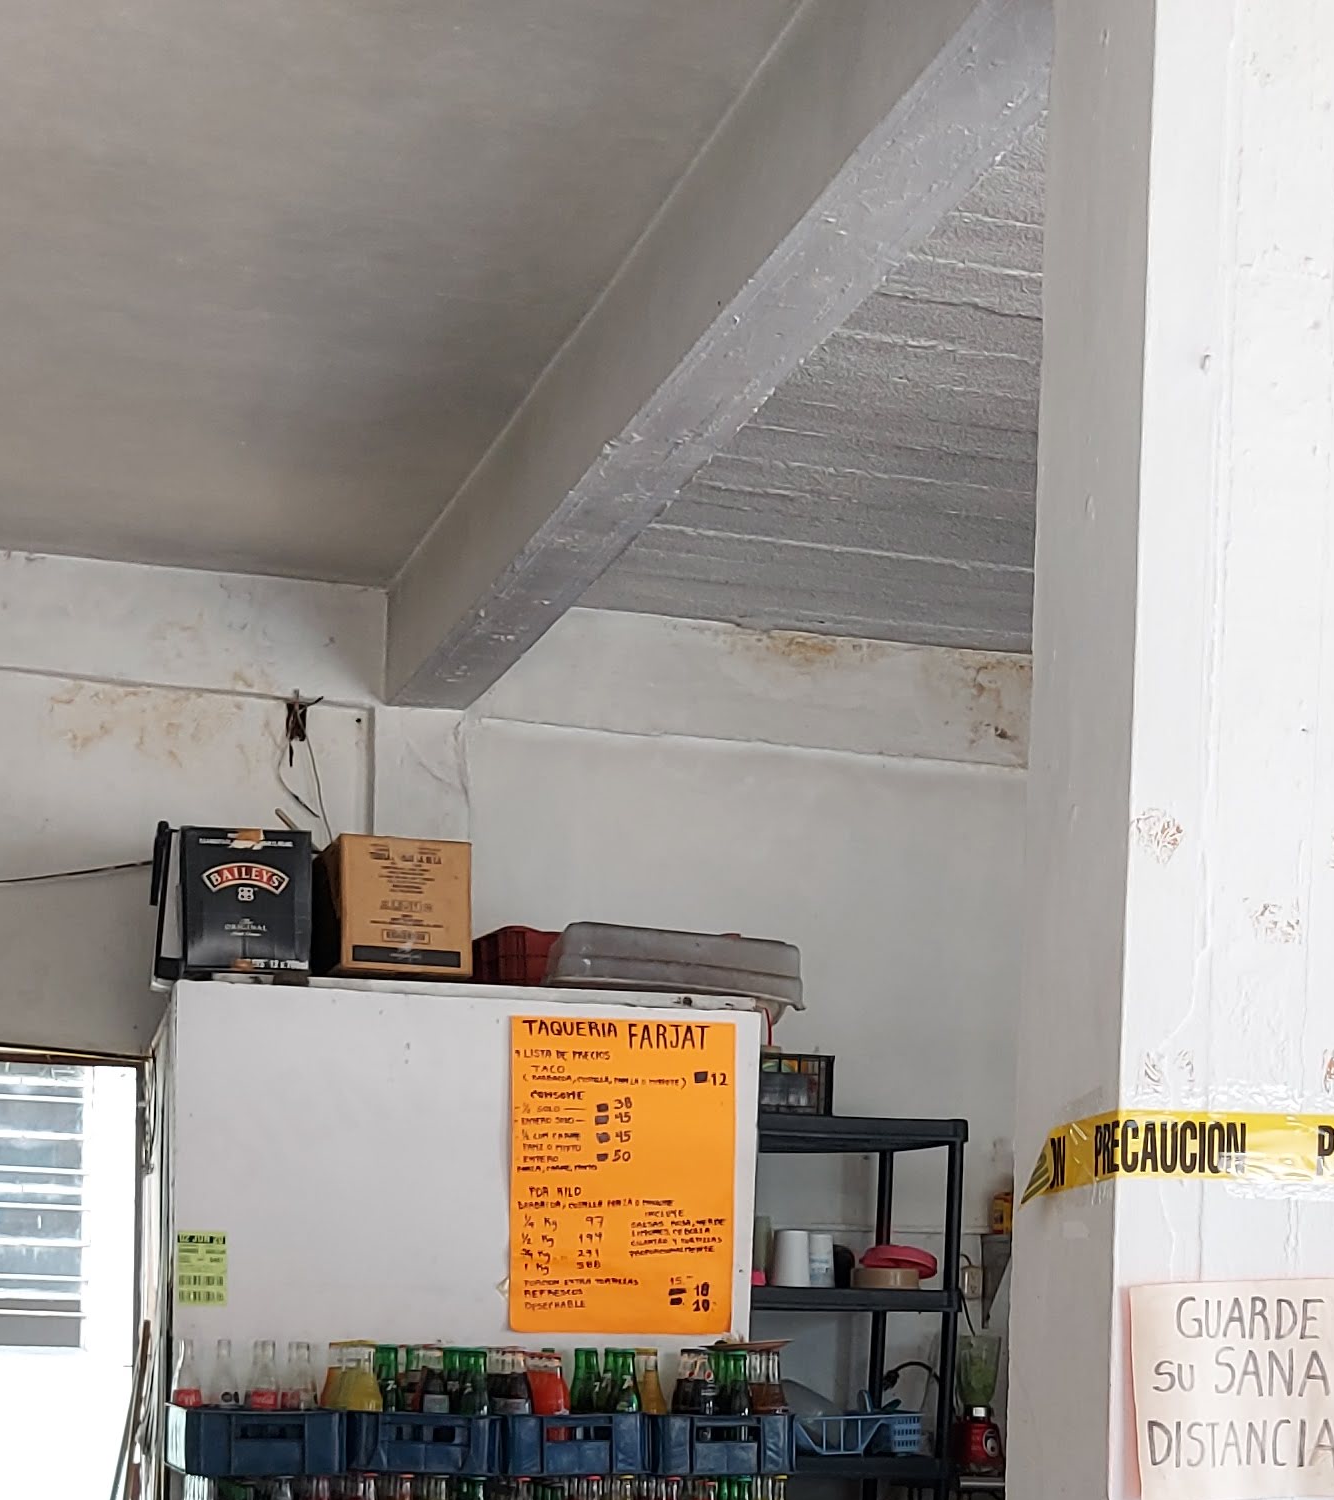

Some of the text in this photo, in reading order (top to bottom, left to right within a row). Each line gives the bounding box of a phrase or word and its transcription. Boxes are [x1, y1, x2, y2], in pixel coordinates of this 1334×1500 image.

[209, 866, 283, 887] BAILEYS
[522, 1019, 711, 1050] TAQUERIA FARJAT
[523, 1049, 611, 1061] LISTA DE PRECIOS
[531, 1065, 566, 1074] TACO
[710, 1072, 728, 1086] 12
[530, 1089, 586, 1100] CONSOME
[613, 1096, 633, 1110] 38
[614, 1111, 632, 1124] 45
[614, 1130, 632, 1143] 45
[1094, 1119, 1247, 1177] PRECAUCION
[611, 1149, 632, 1163] 50
[585, 1215, 604, 1228] 97
[578, 1231, 603, 1244] 194
[1175, 1296, 1326, 1341] GUARDE
[1214, 1346, 1331, 1398] SANA
